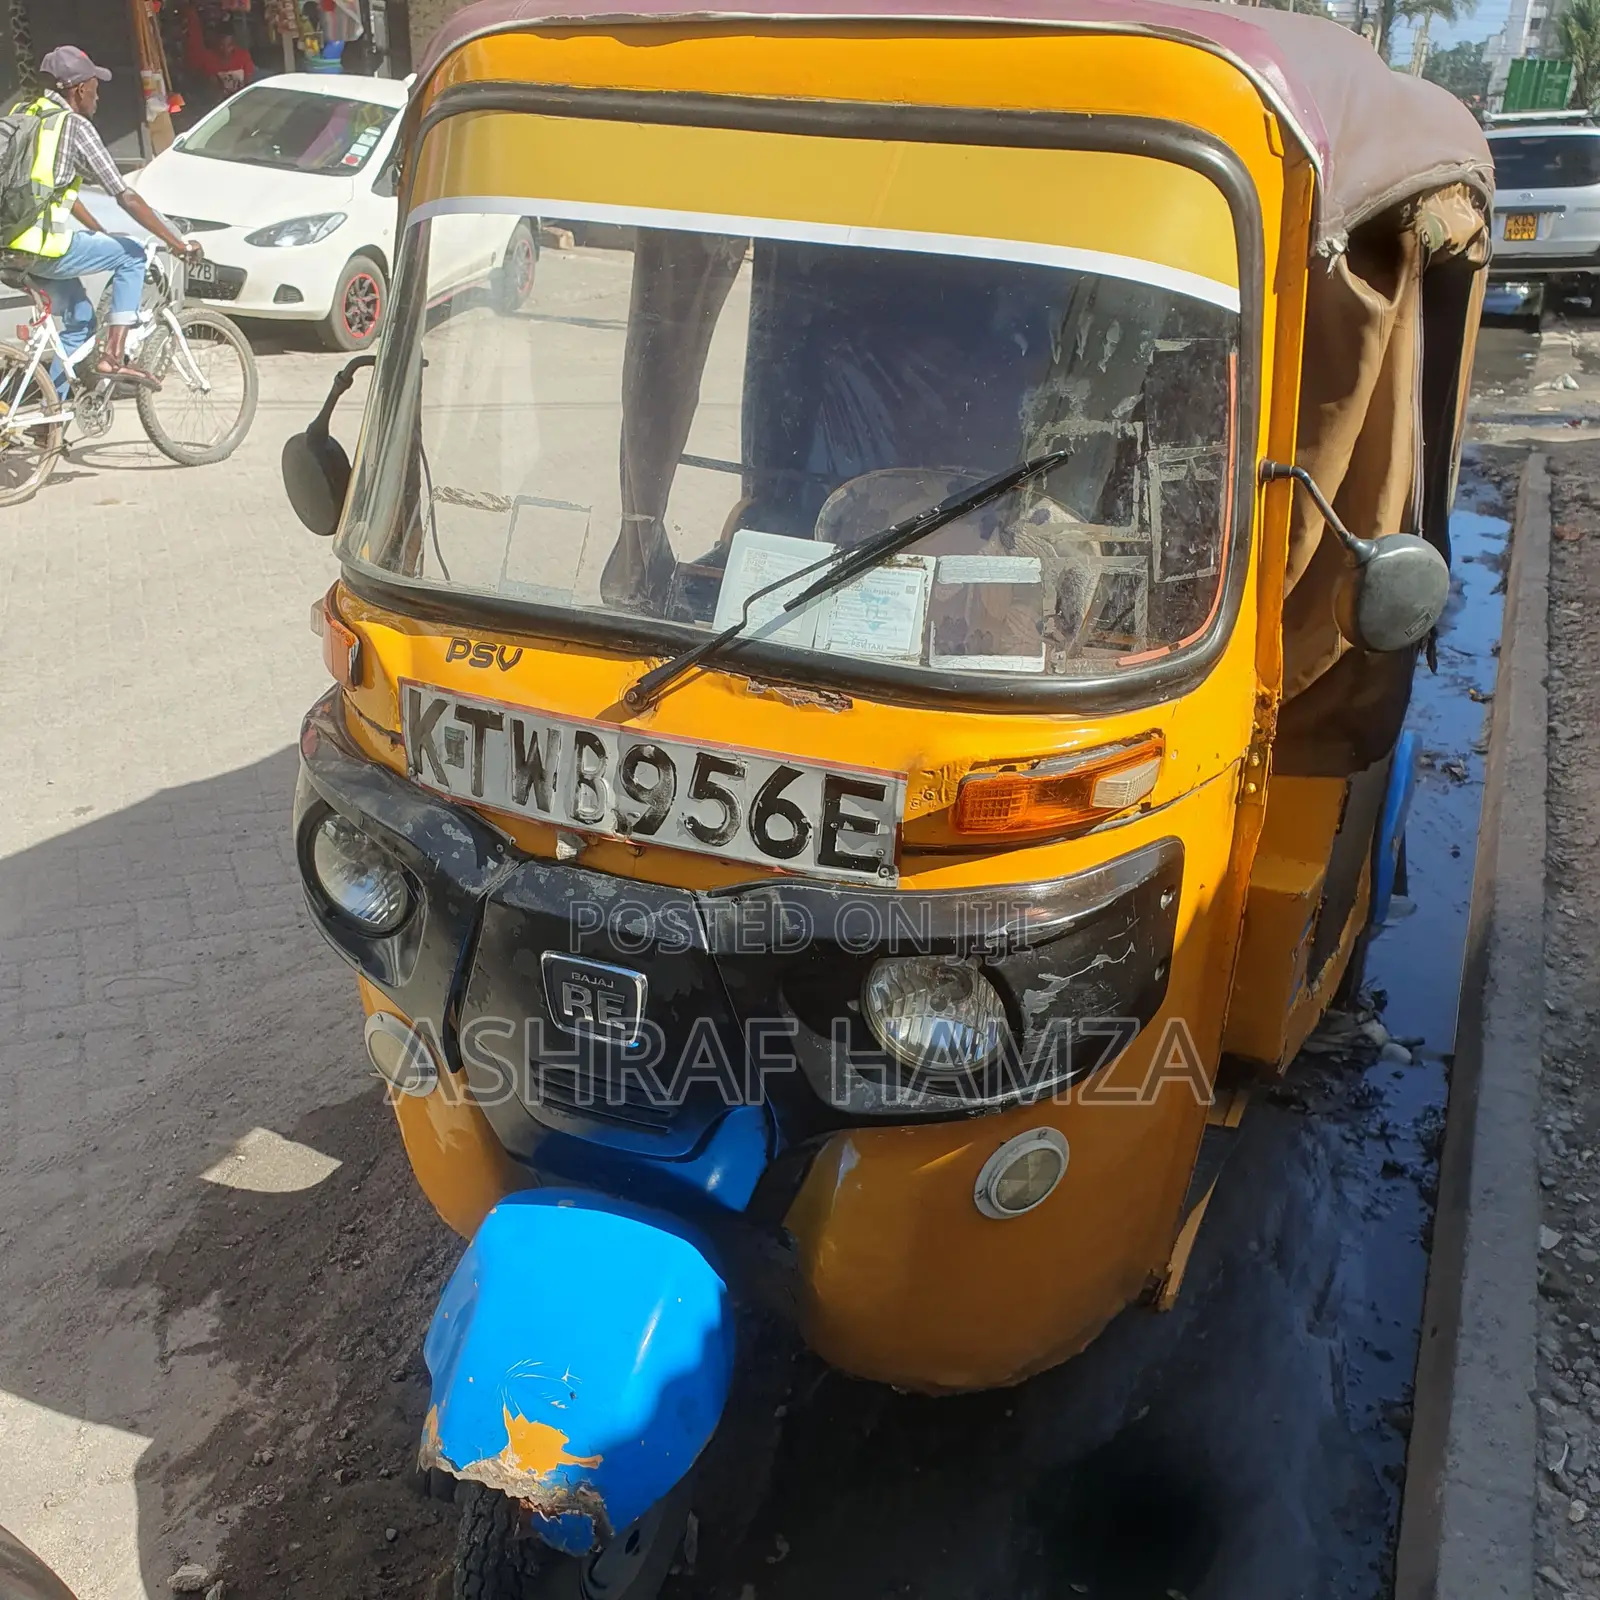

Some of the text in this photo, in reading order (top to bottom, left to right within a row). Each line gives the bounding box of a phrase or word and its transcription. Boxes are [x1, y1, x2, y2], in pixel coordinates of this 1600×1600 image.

[445, 637, 523, 671] PSV
[571, 972, 614, 988] BAJAJ
[562, 981, 626, 1031] RE
